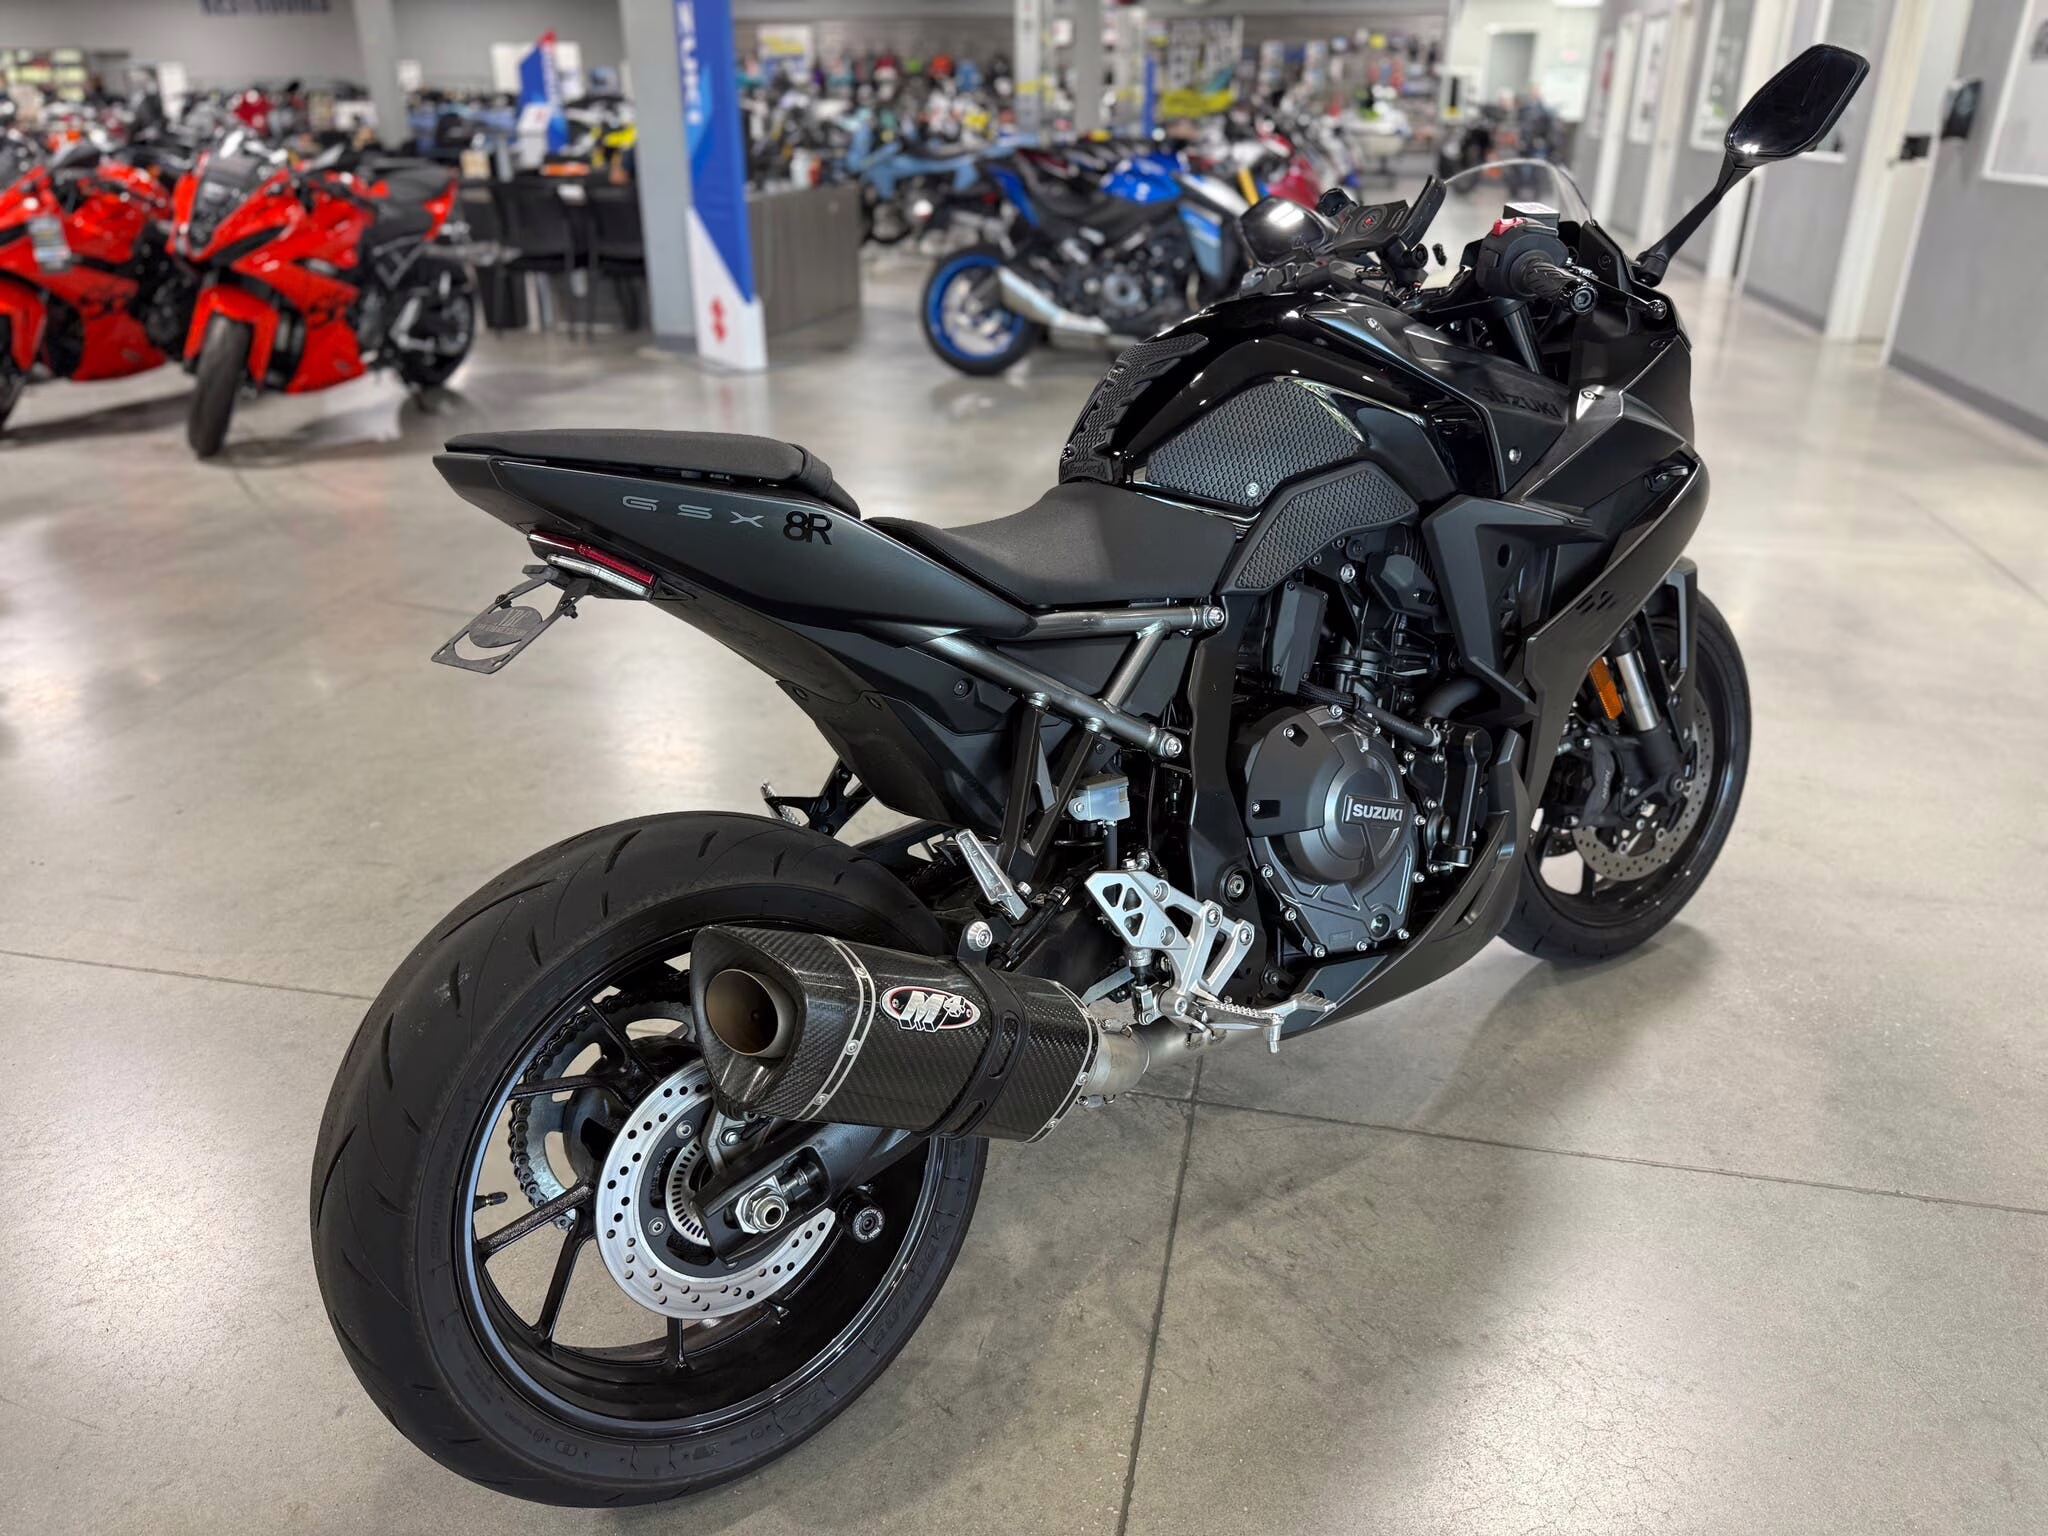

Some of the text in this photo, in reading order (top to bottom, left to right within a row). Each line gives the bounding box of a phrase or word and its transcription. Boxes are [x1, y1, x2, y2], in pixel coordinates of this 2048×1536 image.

[1473, 387, 1563, 419] SUZUKI
[782, 510, 833, 546] 8R
[1352, 803, 1403, 822] SUZUKI
